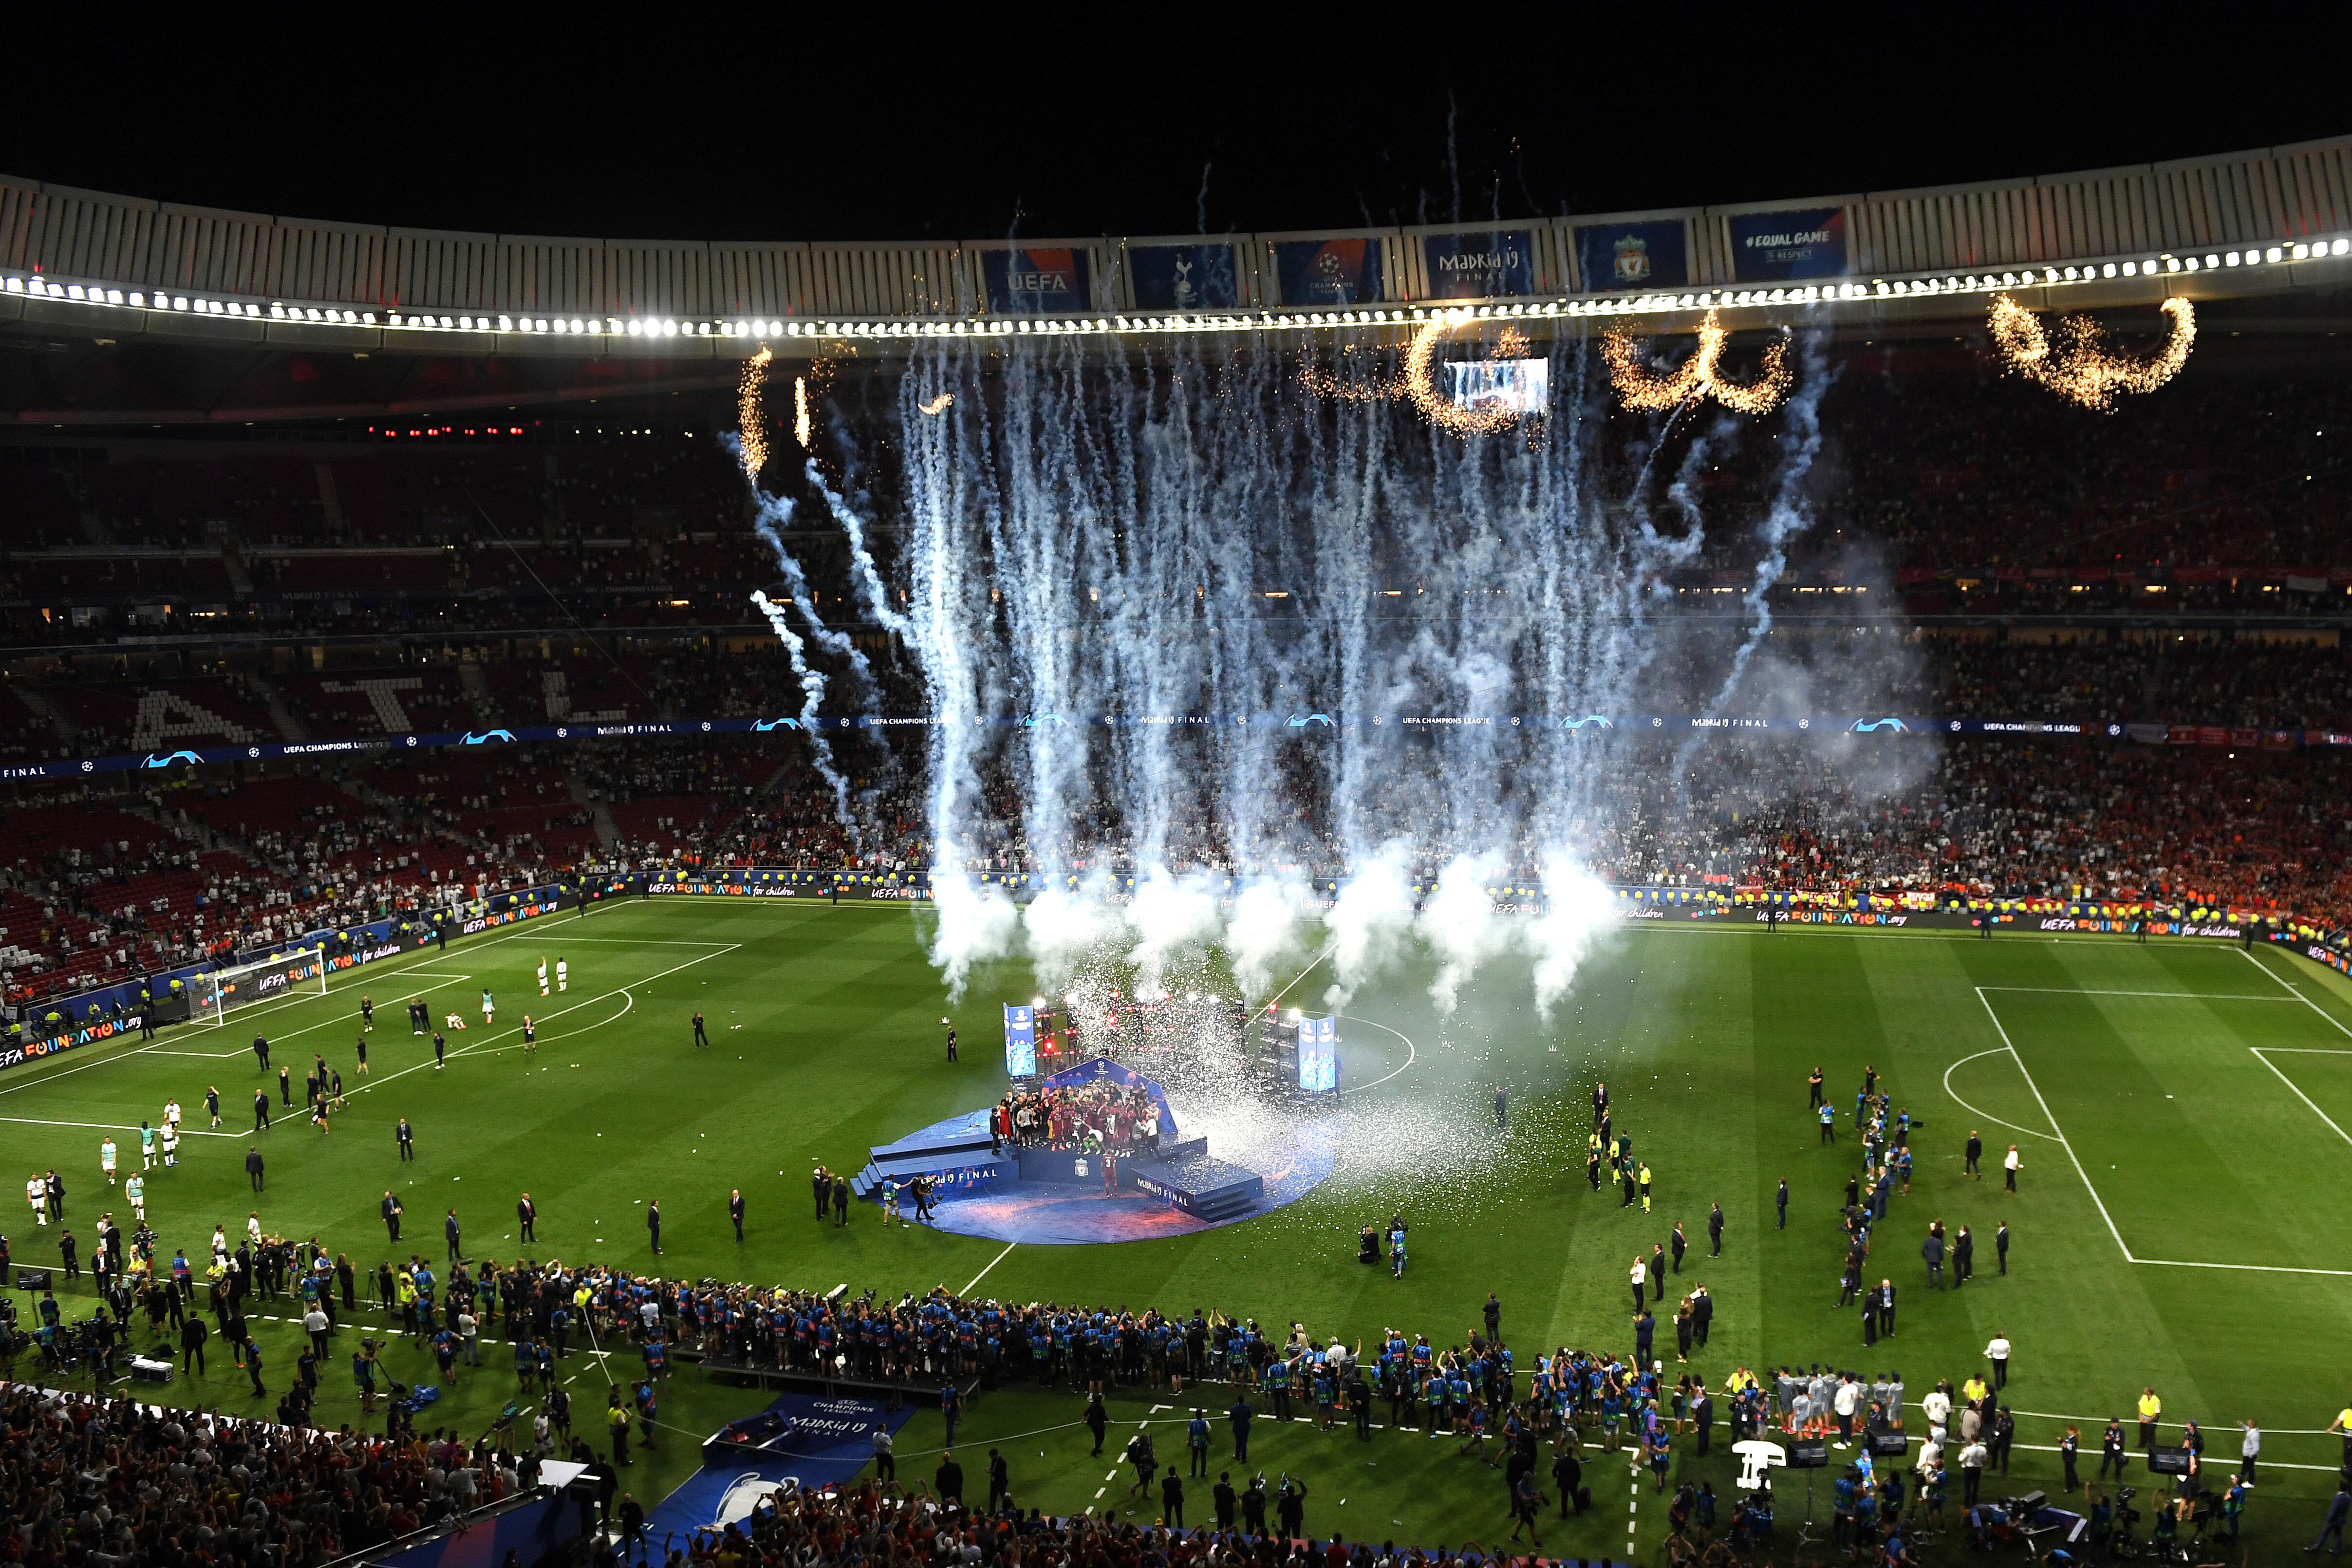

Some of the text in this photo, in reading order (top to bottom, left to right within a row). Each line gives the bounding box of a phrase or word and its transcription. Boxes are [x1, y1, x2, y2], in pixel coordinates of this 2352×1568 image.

[1507, 251, 1518, 268] 19
[1008, 274, 1066, 291] UEFA
[1722, 718, 1729, 727] 19
[1733, 719, 1768, 727] FINAL
[1983, 723, 2005, 731] UEFA
[2054, 724, 2081, 733] LEAGU
[637, 725, 672, 733] FINAL
[306, 742, 352, 752] CHAMPIONS
[3, 766, 45, 778] FINAL
[648, 883, 795, 897] UEFA FOUNDATION for children
[871, 888, 899, 898] UEFA
[464, 919, 486, 933] UEFA
[486, 903, 546, 926] FOUNDATION
[1628, 908, 1663, 918] children
[1792, 912, 1886, 925] FOUNDATION
[2040, 919, 2076, 930] UEFA
[2182, 924, 2199, 937] for
[2199, 925, 2240, 937] children
[362, 950, 373, 965] for
[374, 944, 401, 959] children
[2308, 945, 2326, 961] UEFA
[0, 1049, 24, 1066] EFA
[25, 1019, 124, 1056] FOUNDATION
[1106, 1158, 1111, 1168] 3
[948, 1174, 954, 1183] 19
[959, 1169, 997, 1181] FINAL
[1164, 1190, 1188, 1207] FINAL
[813, 1402, 875, 1413] CHAMPIONS
[796, 1427, 842, 1437] FINAL
[852, 1422, 868, 1433] 19
